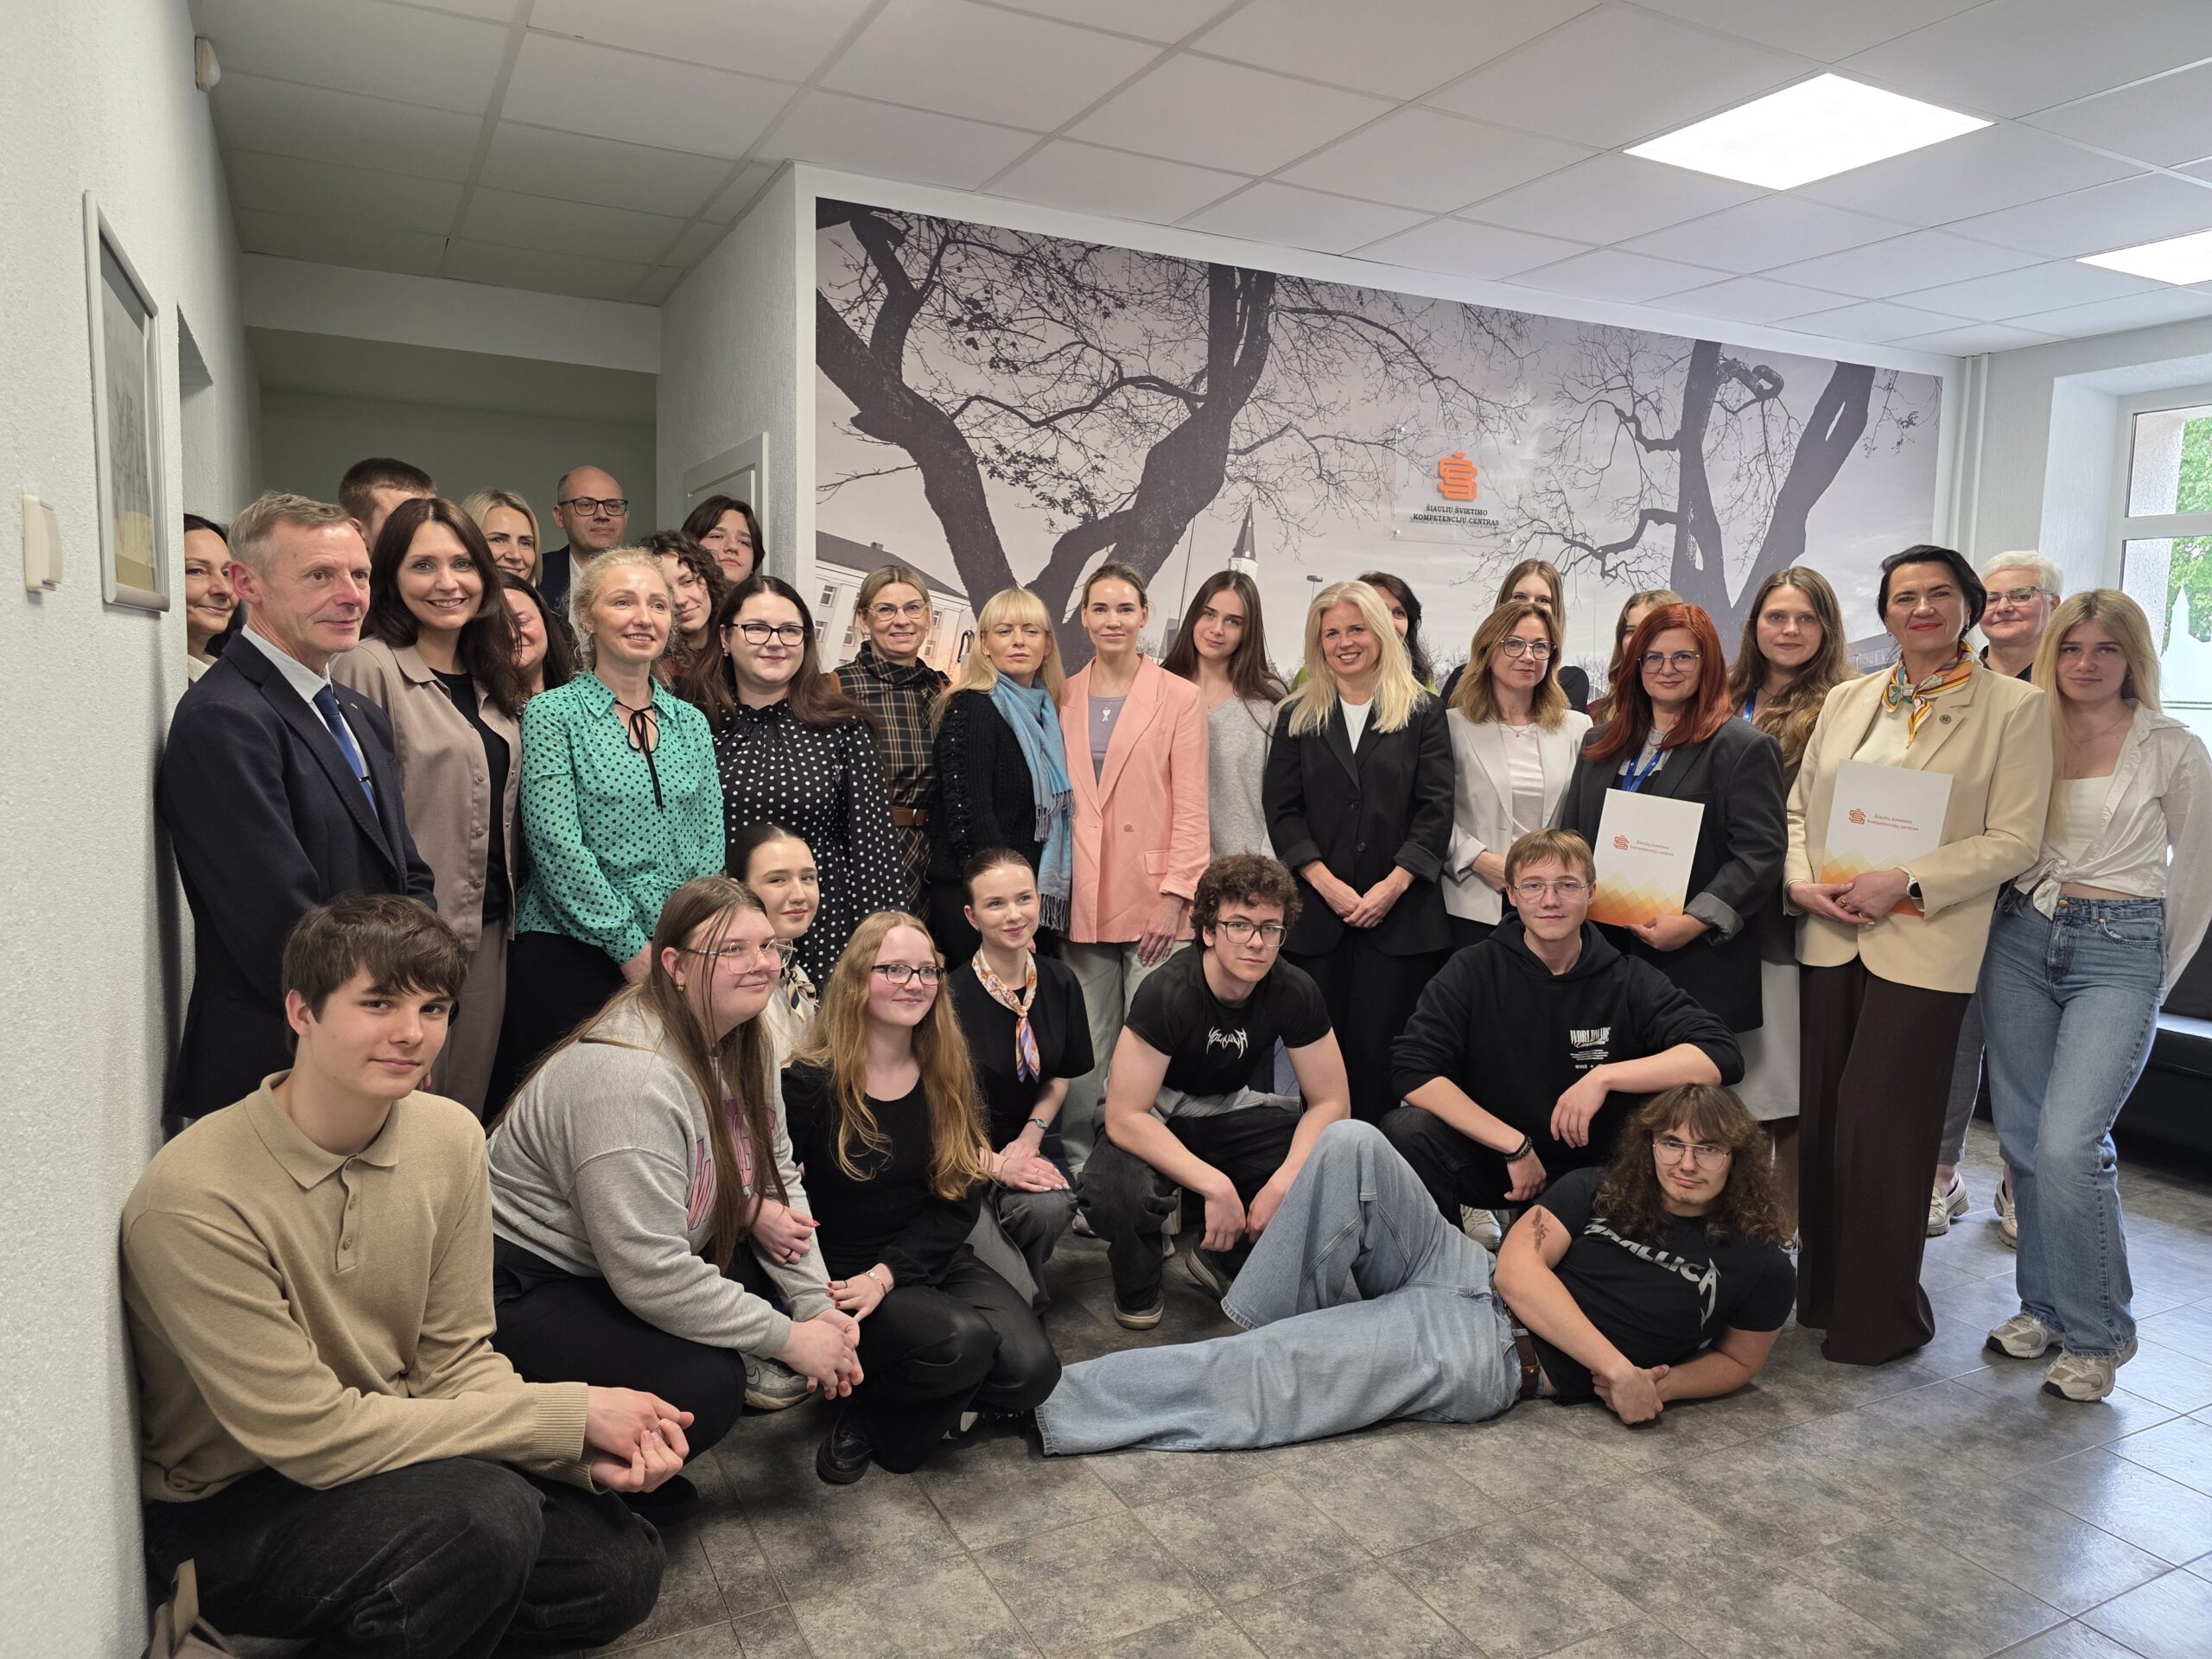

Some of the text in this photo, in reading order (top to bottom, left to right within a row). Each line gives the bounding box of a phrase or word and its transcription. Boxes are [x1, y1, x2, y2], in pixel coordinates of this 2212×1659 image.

[1426, 504, 1488, 516] ŠIAULIŲ ŠVIETIMO
[1413, 513, 1499, 526] KOMPETENCIJŲ CENTRAS
